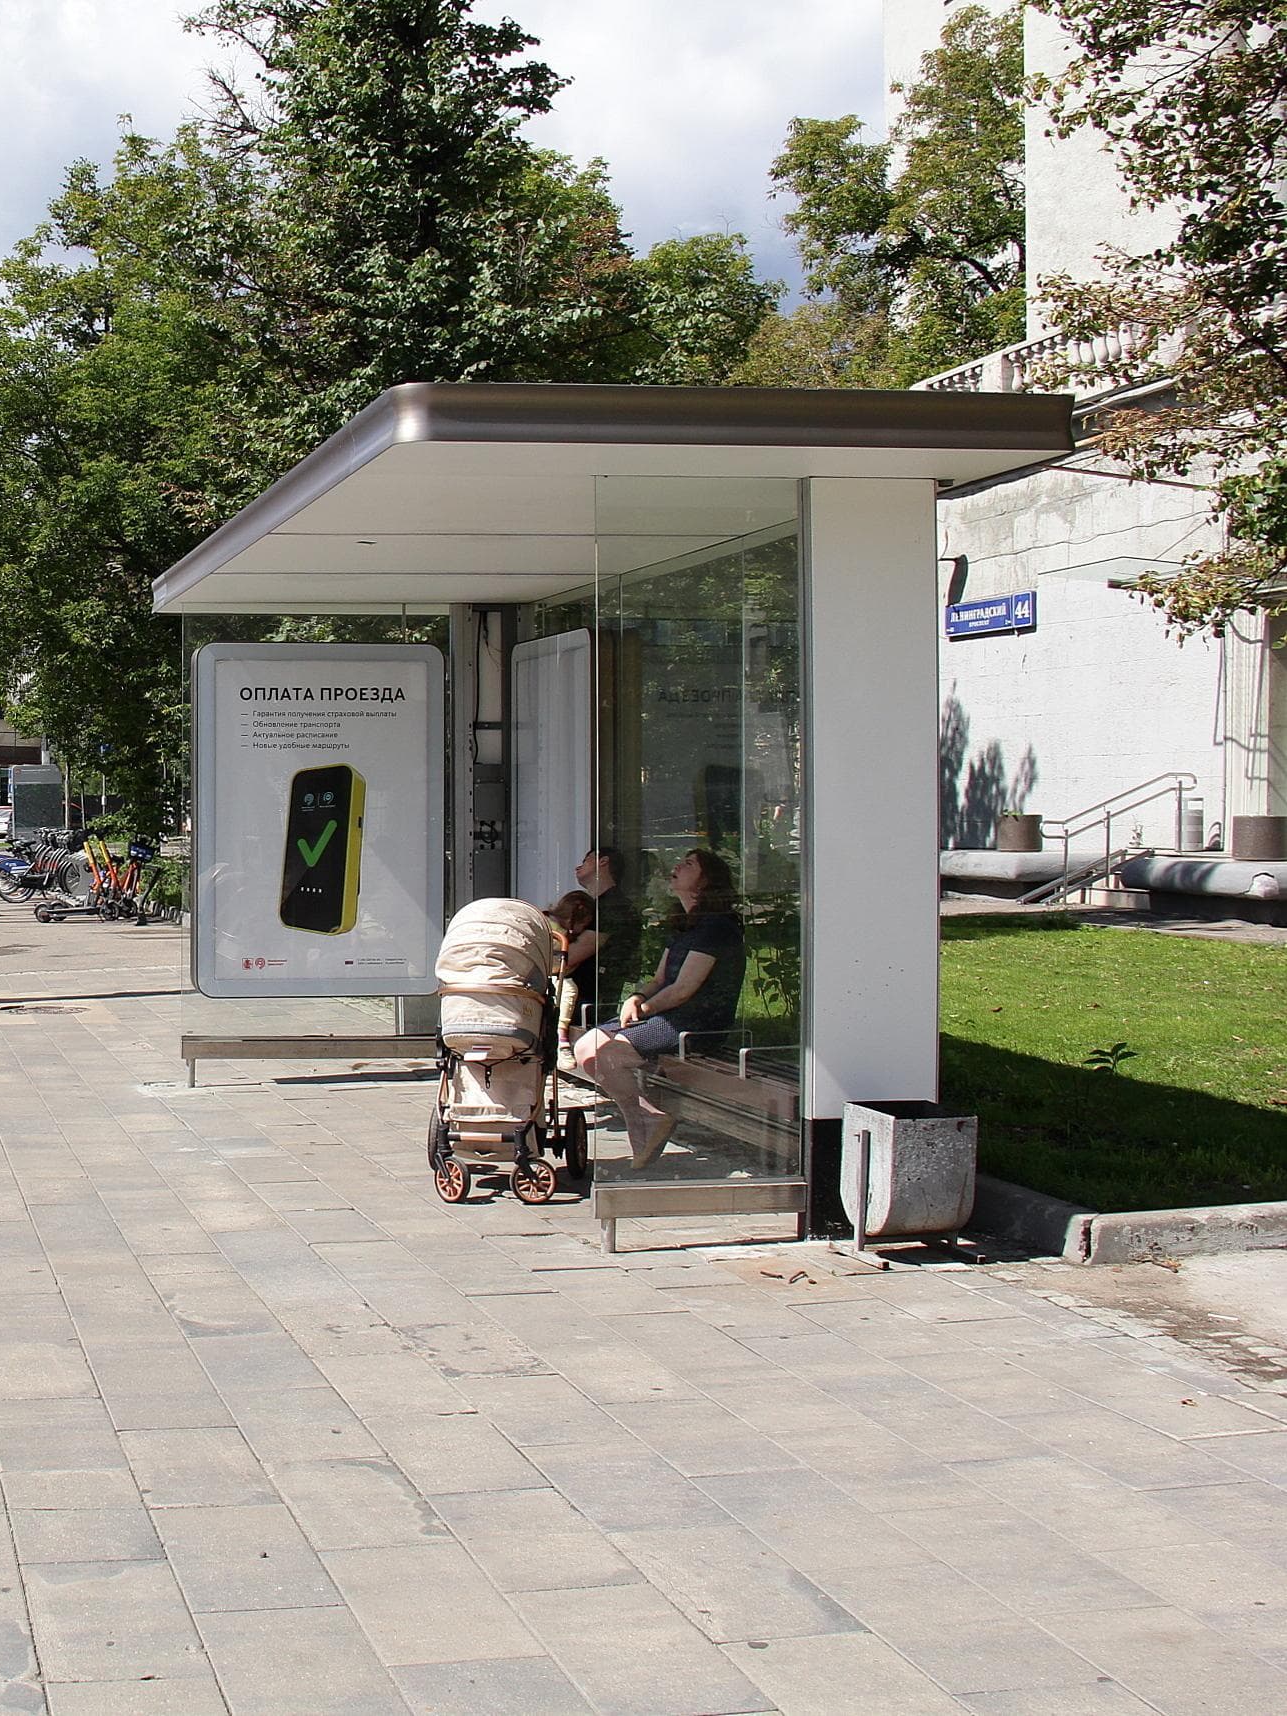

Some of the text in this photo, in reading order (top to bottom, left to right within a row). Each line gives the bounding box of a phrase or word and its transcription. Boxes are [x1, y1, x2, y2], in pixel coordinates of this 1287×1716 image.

[1014, 600, 1030, 619] 44
[240, 687, 406, 703] ОПЛАТА ПРОЕЗДА
[252, 710, 286, 718] Гарантия
[287, 711, 326, 719] получения
[326, 710, 365, 719] страховой
[252, 720, 298, 728] Обновление
[252, 731, 295, 739] Актуальное
[279, 742, 311, 750] удобные
